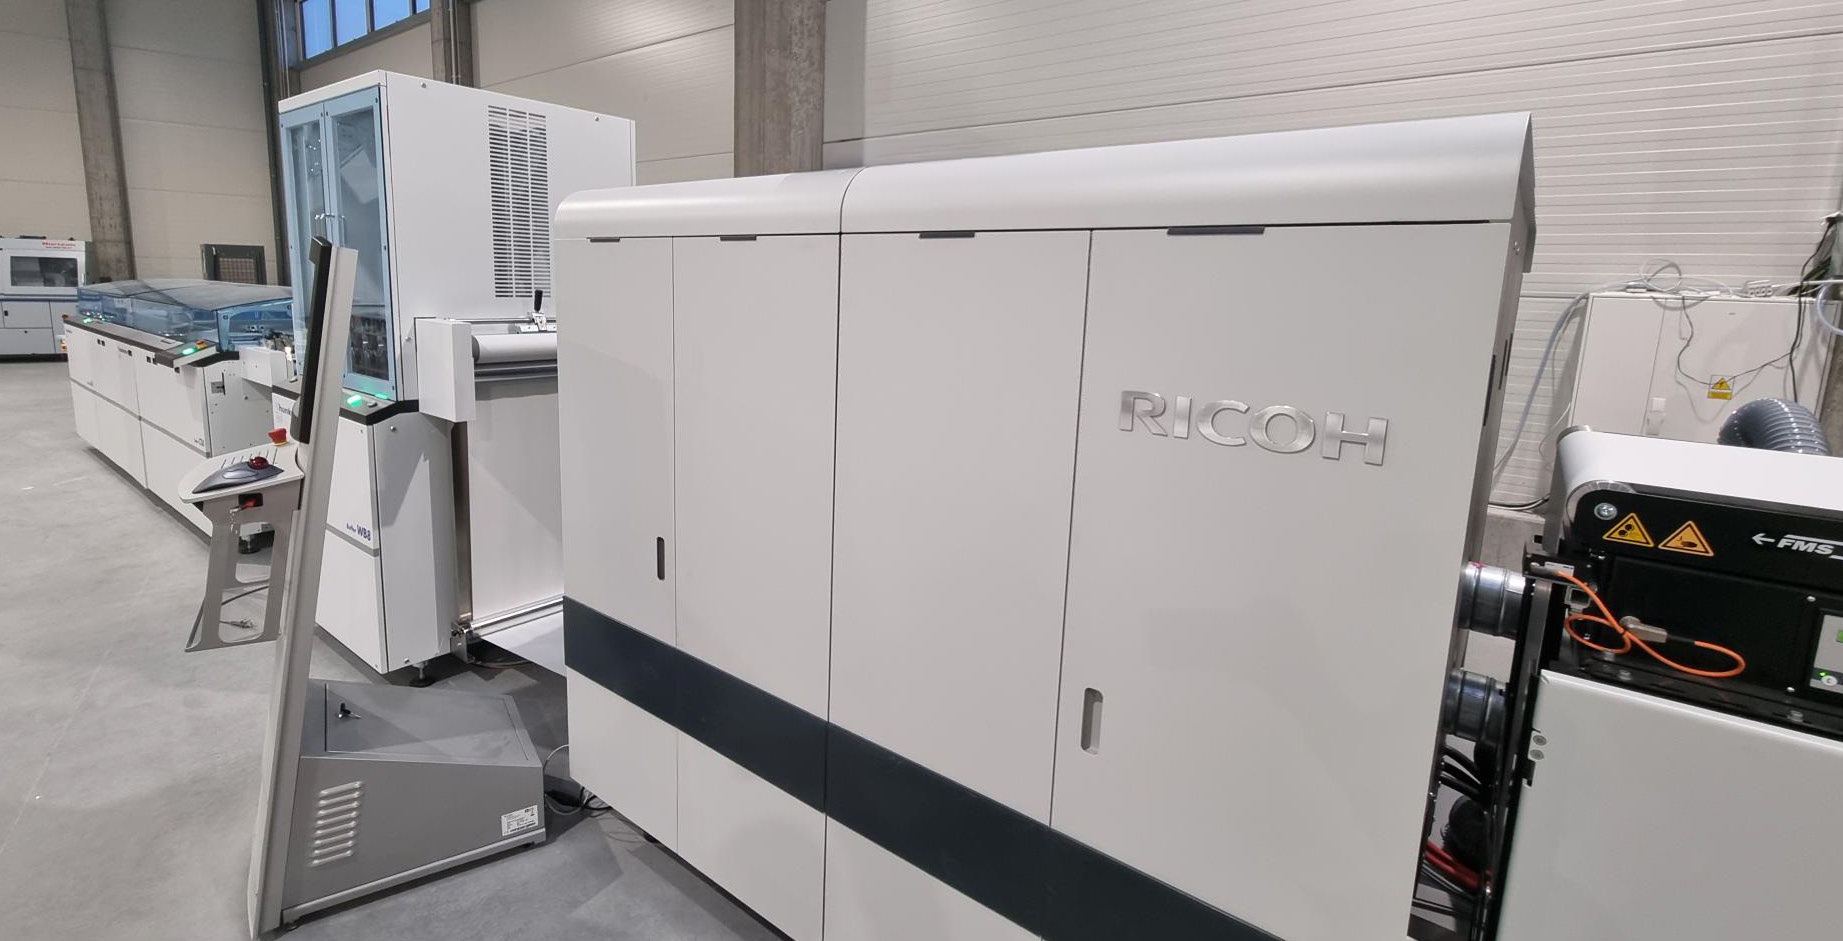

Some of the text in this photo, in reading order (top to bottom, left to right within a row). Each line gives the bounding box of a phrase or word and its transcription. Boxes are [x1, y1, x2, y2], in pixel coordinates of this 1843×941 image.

[1119, 390, 1388, 466] RICOH
[356, 523, 371, 541] WB8
[1777, 538, 1835, 555] FMS
